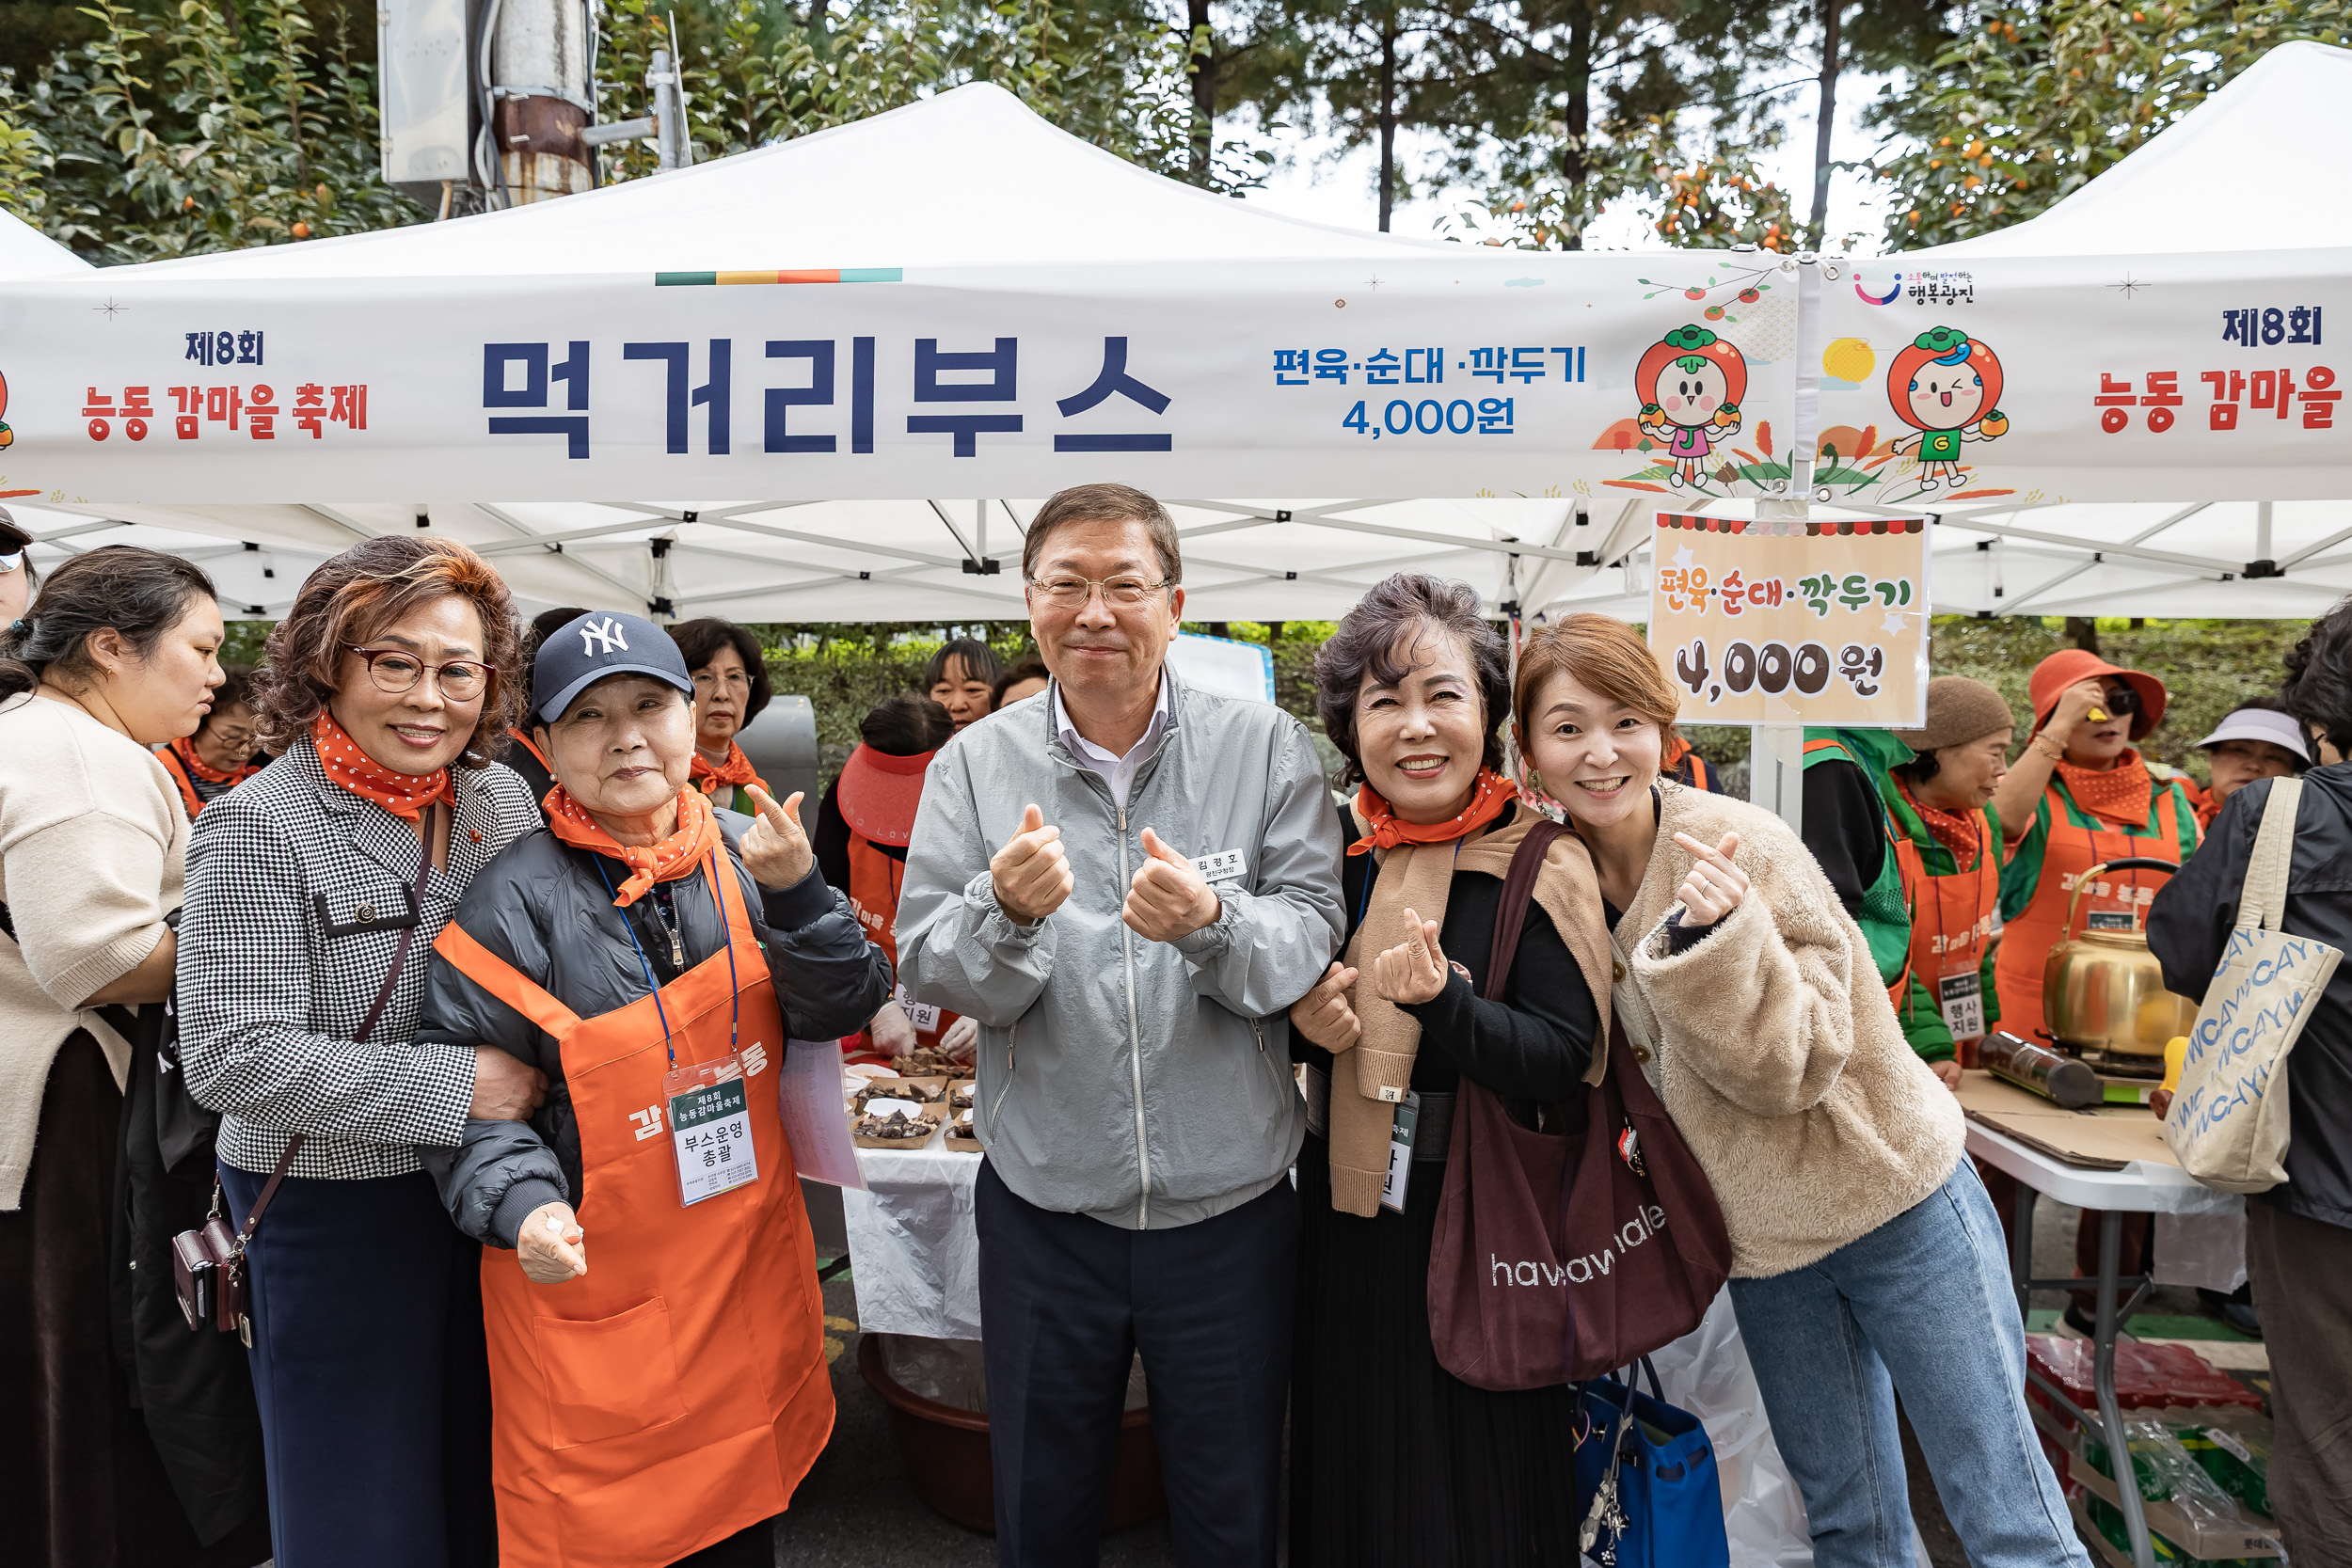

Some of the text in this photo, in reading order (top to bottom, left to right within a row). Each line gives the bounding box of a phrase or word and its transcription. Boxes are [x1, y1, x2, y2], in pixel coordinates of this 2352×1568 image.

[1908, 283, 1974, 306] 행복광진
[2222, 306, 2322, 347] 제8회
[184, 329, 264, 366] 제8회
[82, 383, 368, 442] 능동 감마을 축제
[483, 336, 1172, 459] 먹거리부스
[2094, 366, 2343, 434] 능동 감마을
[1342, 397, 1515, 440] 4,000원
[580, 616, 629, 657] NY
[1952, 1016, 1979, 1035] 지원
[697, 1090, 722, 1105] 제8회
[684, 1120, 743, 1153] 부스운영
[703, 1144, 732, 1167] 총괄
